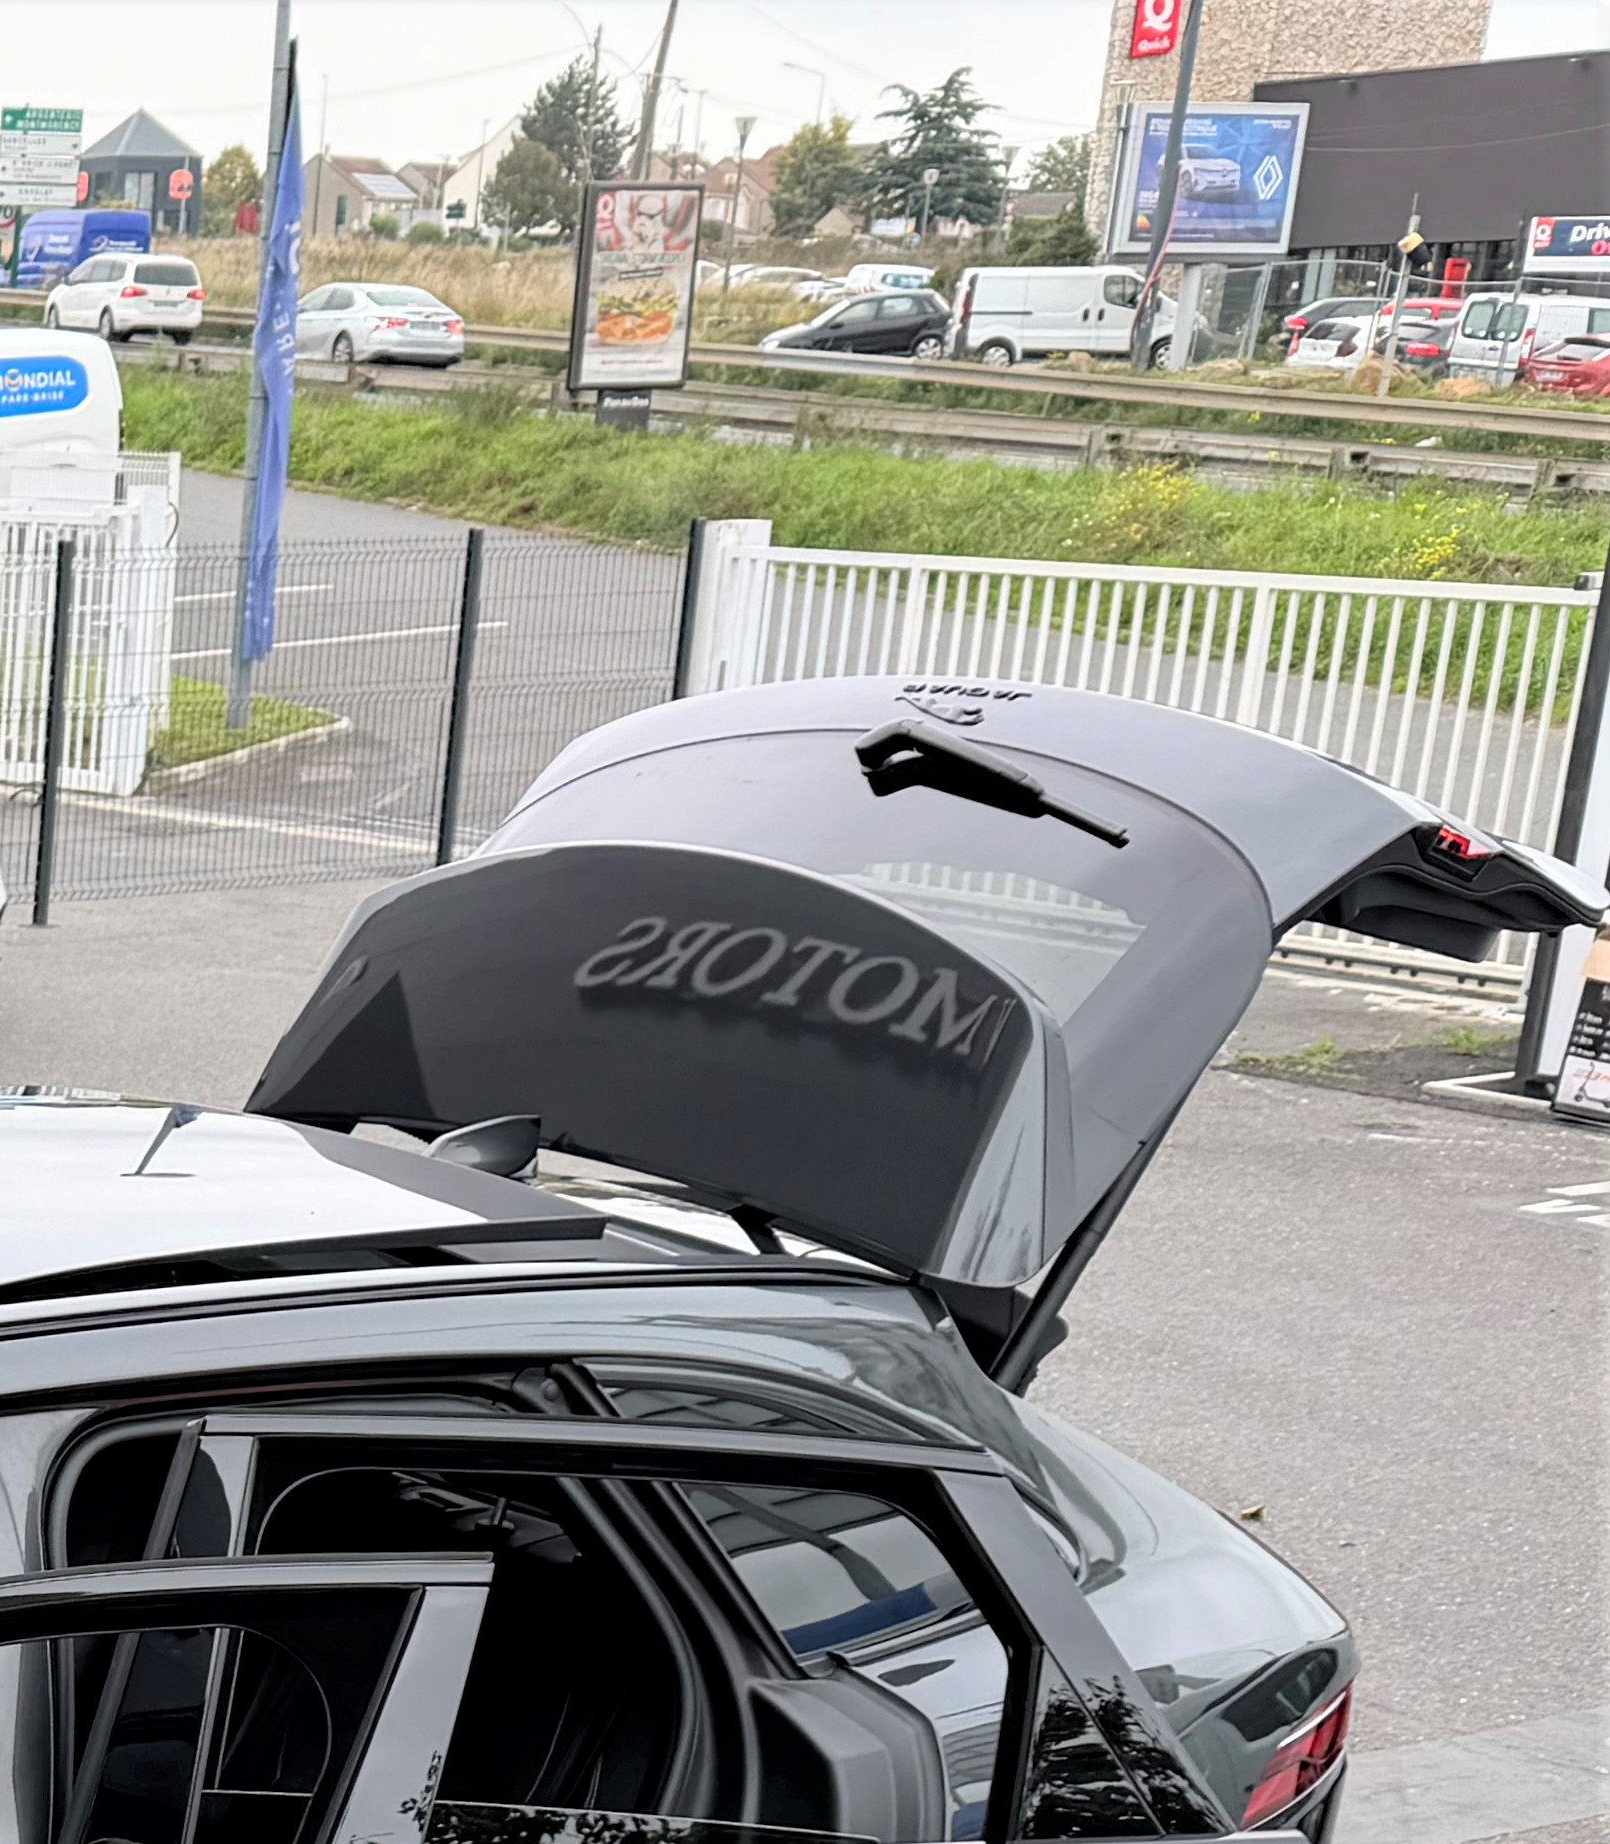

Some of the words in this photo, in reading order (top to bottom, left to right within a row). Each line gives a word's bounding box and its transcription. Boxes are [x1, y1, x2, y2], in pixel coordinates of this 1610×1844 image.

[1138, 36, 1171, 51] Quick
[1, 390, 65, 405] PARE-BRISE
[903, 684, 1033, 701] JAGUAR
